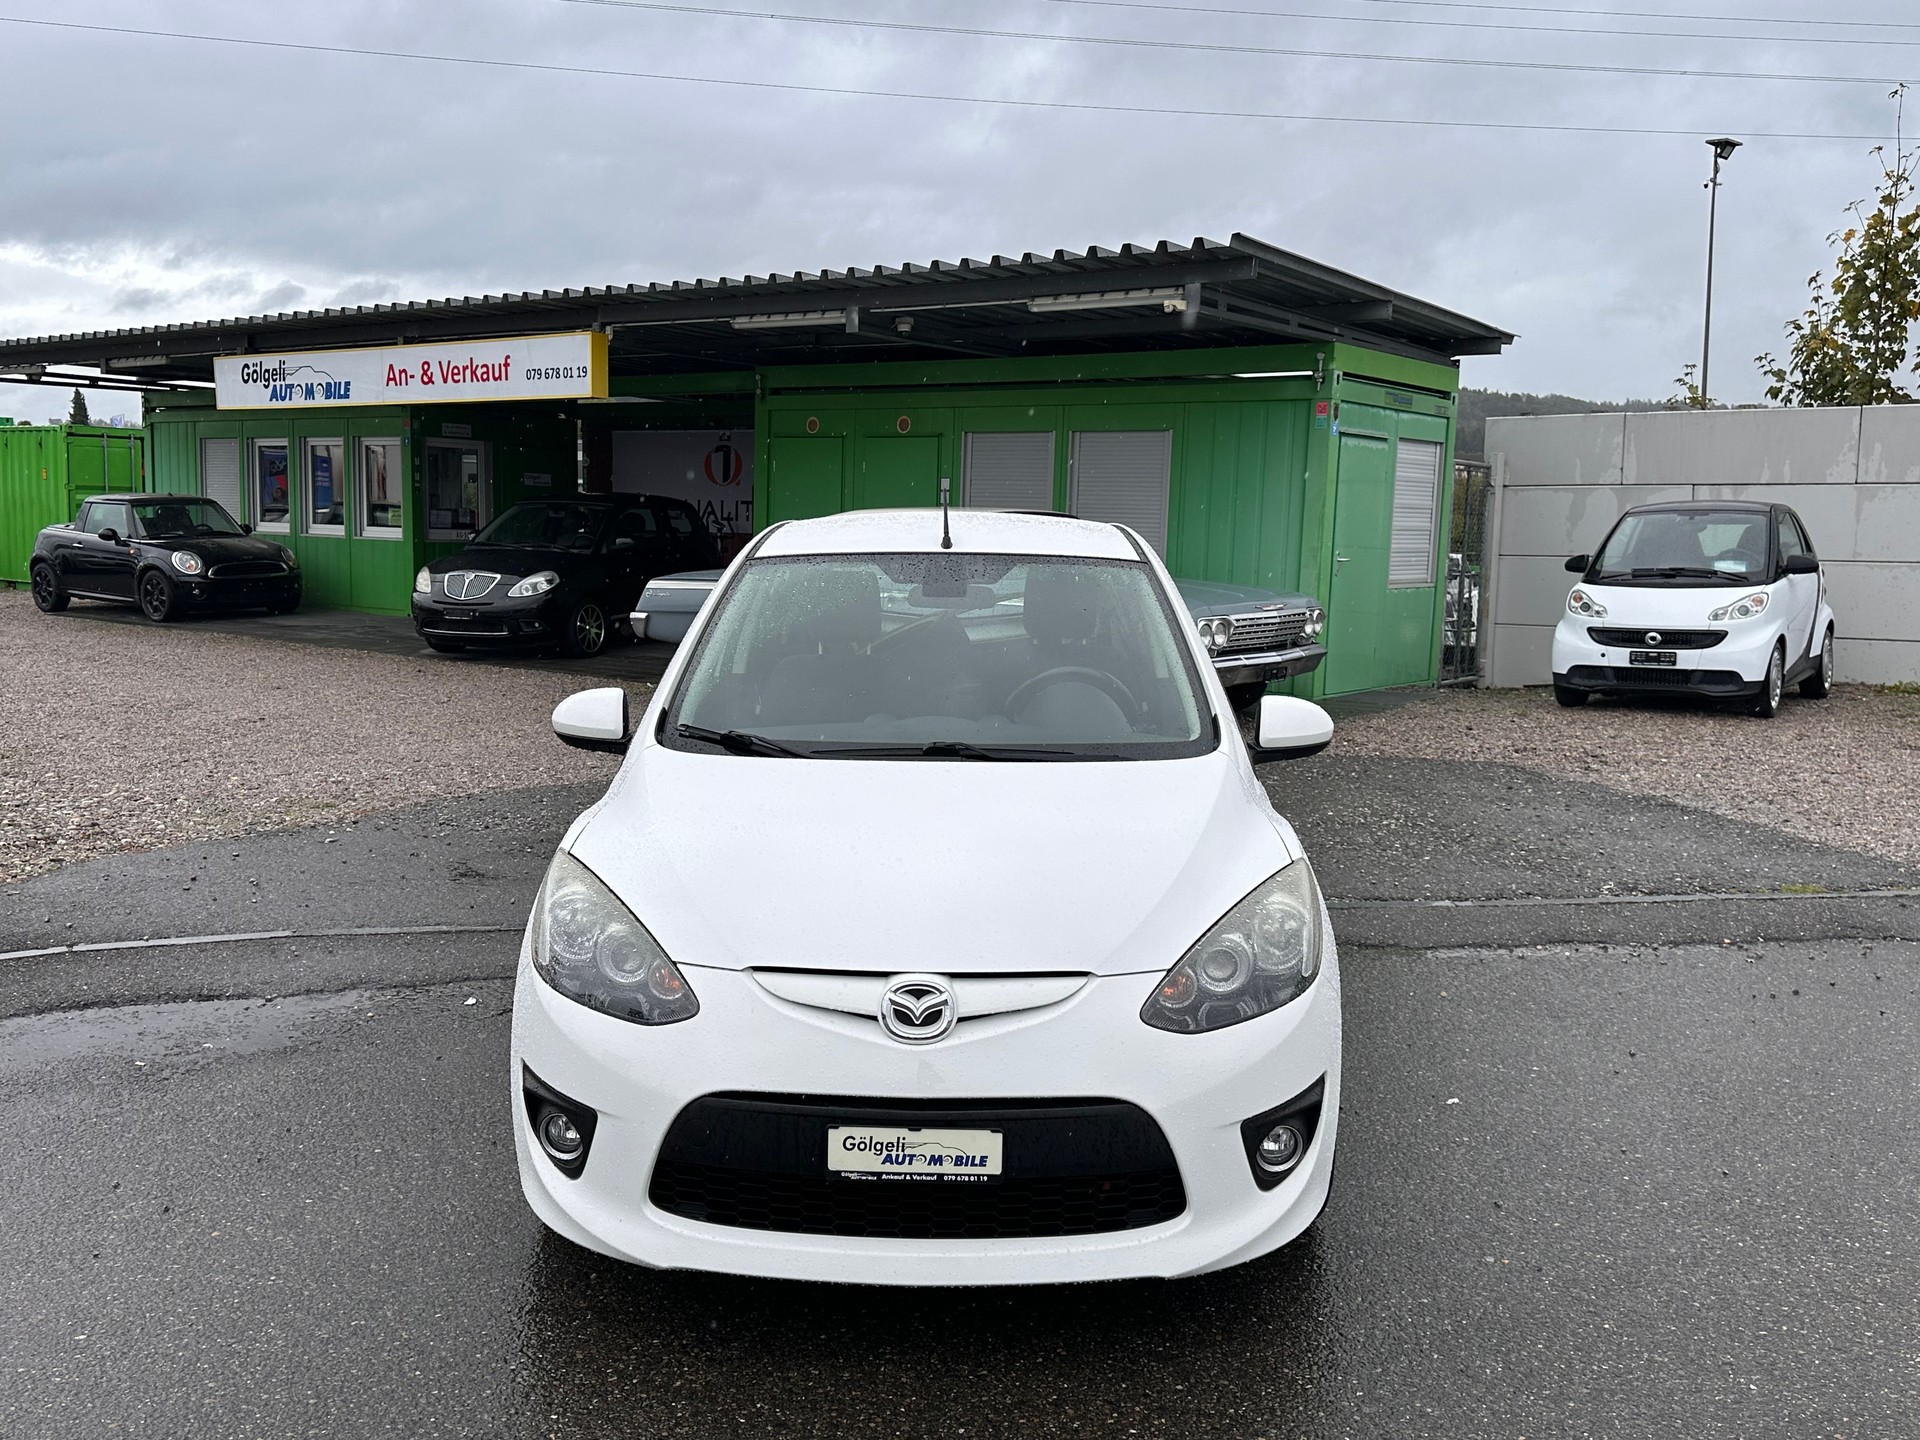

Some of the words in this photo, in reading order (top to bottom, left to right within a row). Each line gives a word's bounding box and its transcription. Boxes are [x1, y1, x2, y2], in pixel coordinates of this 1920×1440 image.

[241, 359, 286, 389] Gölgeli
[385, 363, 415, 387] An-
[420, 360, 435, 386] &
[438, 354, 511, 384] Verkauf
[525, 368, 542, 381] 079
[544, 366, 561, 380] 678
[562, 366, 574, 379] 01
[576, 365, 588, 378] 19
[269, 380, 352, 402] AUTOMOBILE
[842, 1135, 906, 1157] Gölgeli
[880, 1152, 989, 1168] AUTOMOBILE
